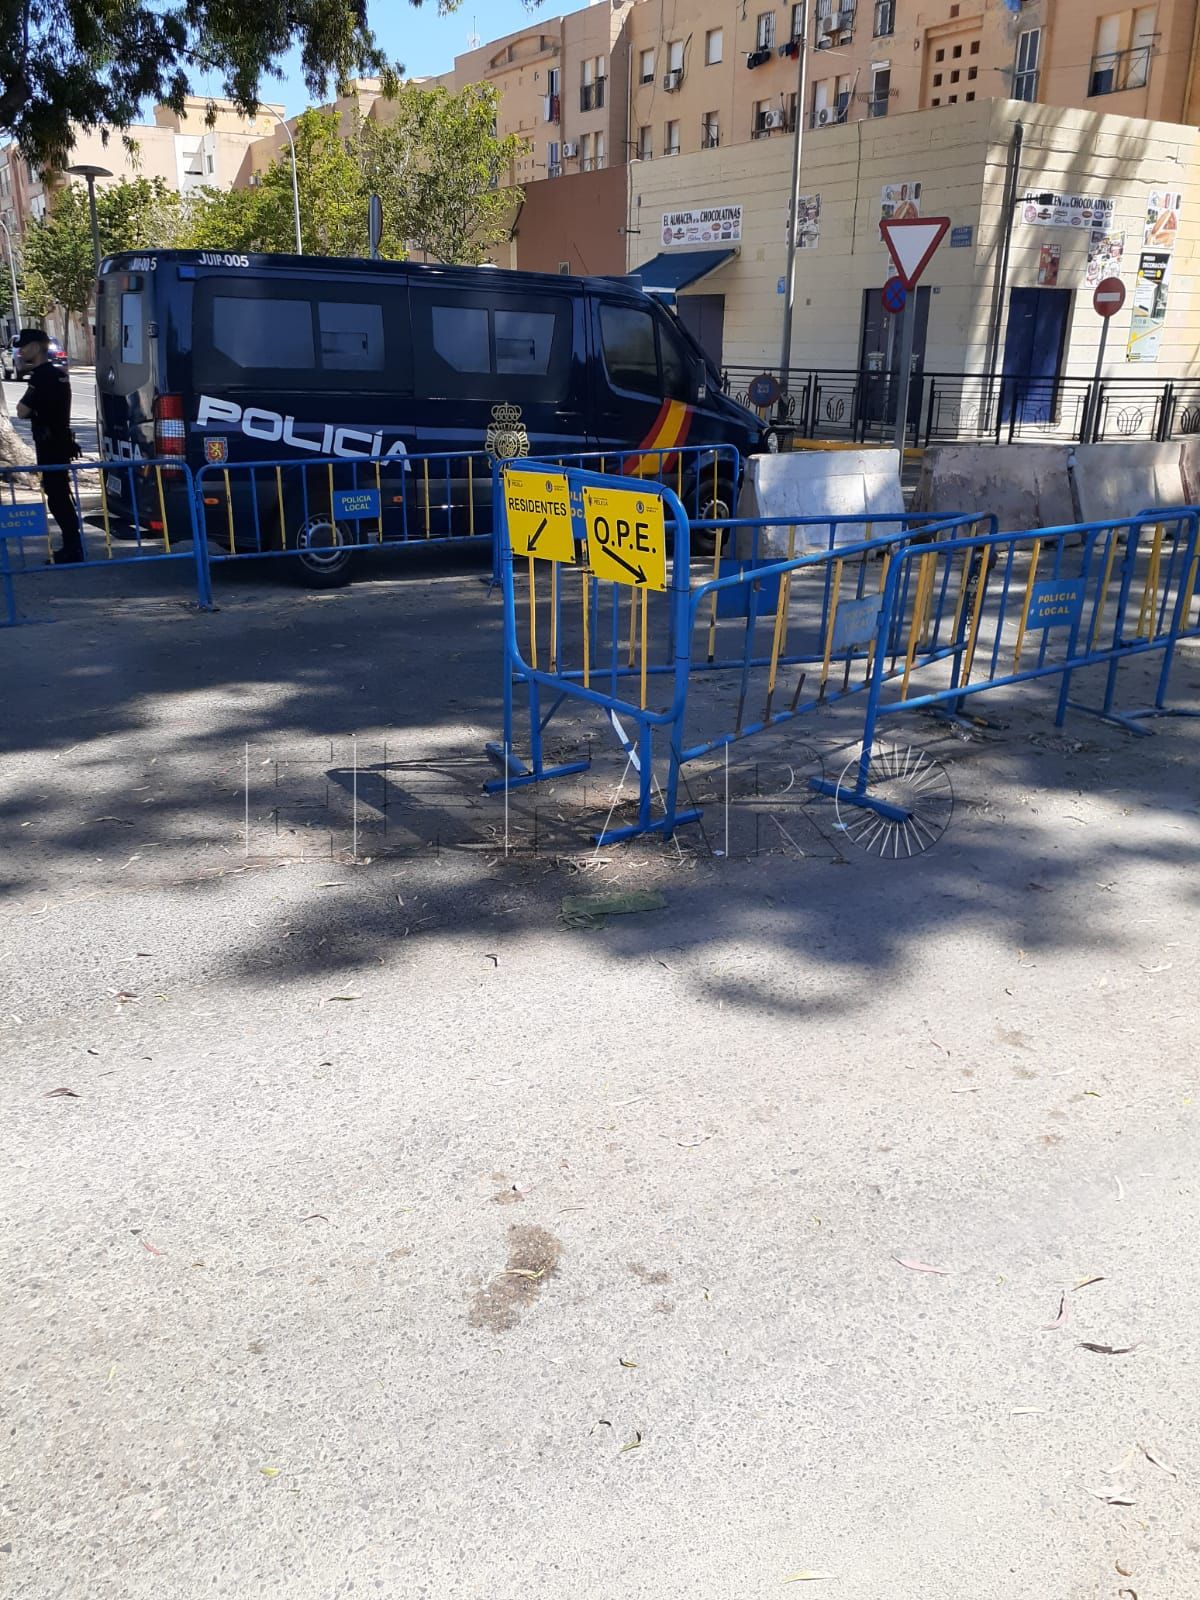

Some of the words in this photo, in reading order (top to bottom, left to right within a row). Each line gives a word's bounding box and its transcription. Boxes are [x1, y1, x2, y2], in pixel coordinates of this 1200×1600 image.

[1071, 197, 1113, 211] CHOCOLATINAS
[664, 215, 669, 226] EL
[670, 213, 692, 226] ALMACEN
[700, 208, 741, 223] CHOCOLATINAS
[198, 252, 249, 268] JUIP-005
[341, 495, 372, 504] POLICIA
[344, 503, 369, 512] LOCAL
[508, 497, 567, 516] RESIDENTES
[594, 516, 656, 554] O.P.E.
[1038, 592, 1076, 604] POLICIA
[1039, 605, 1070, 616] LOCAL
